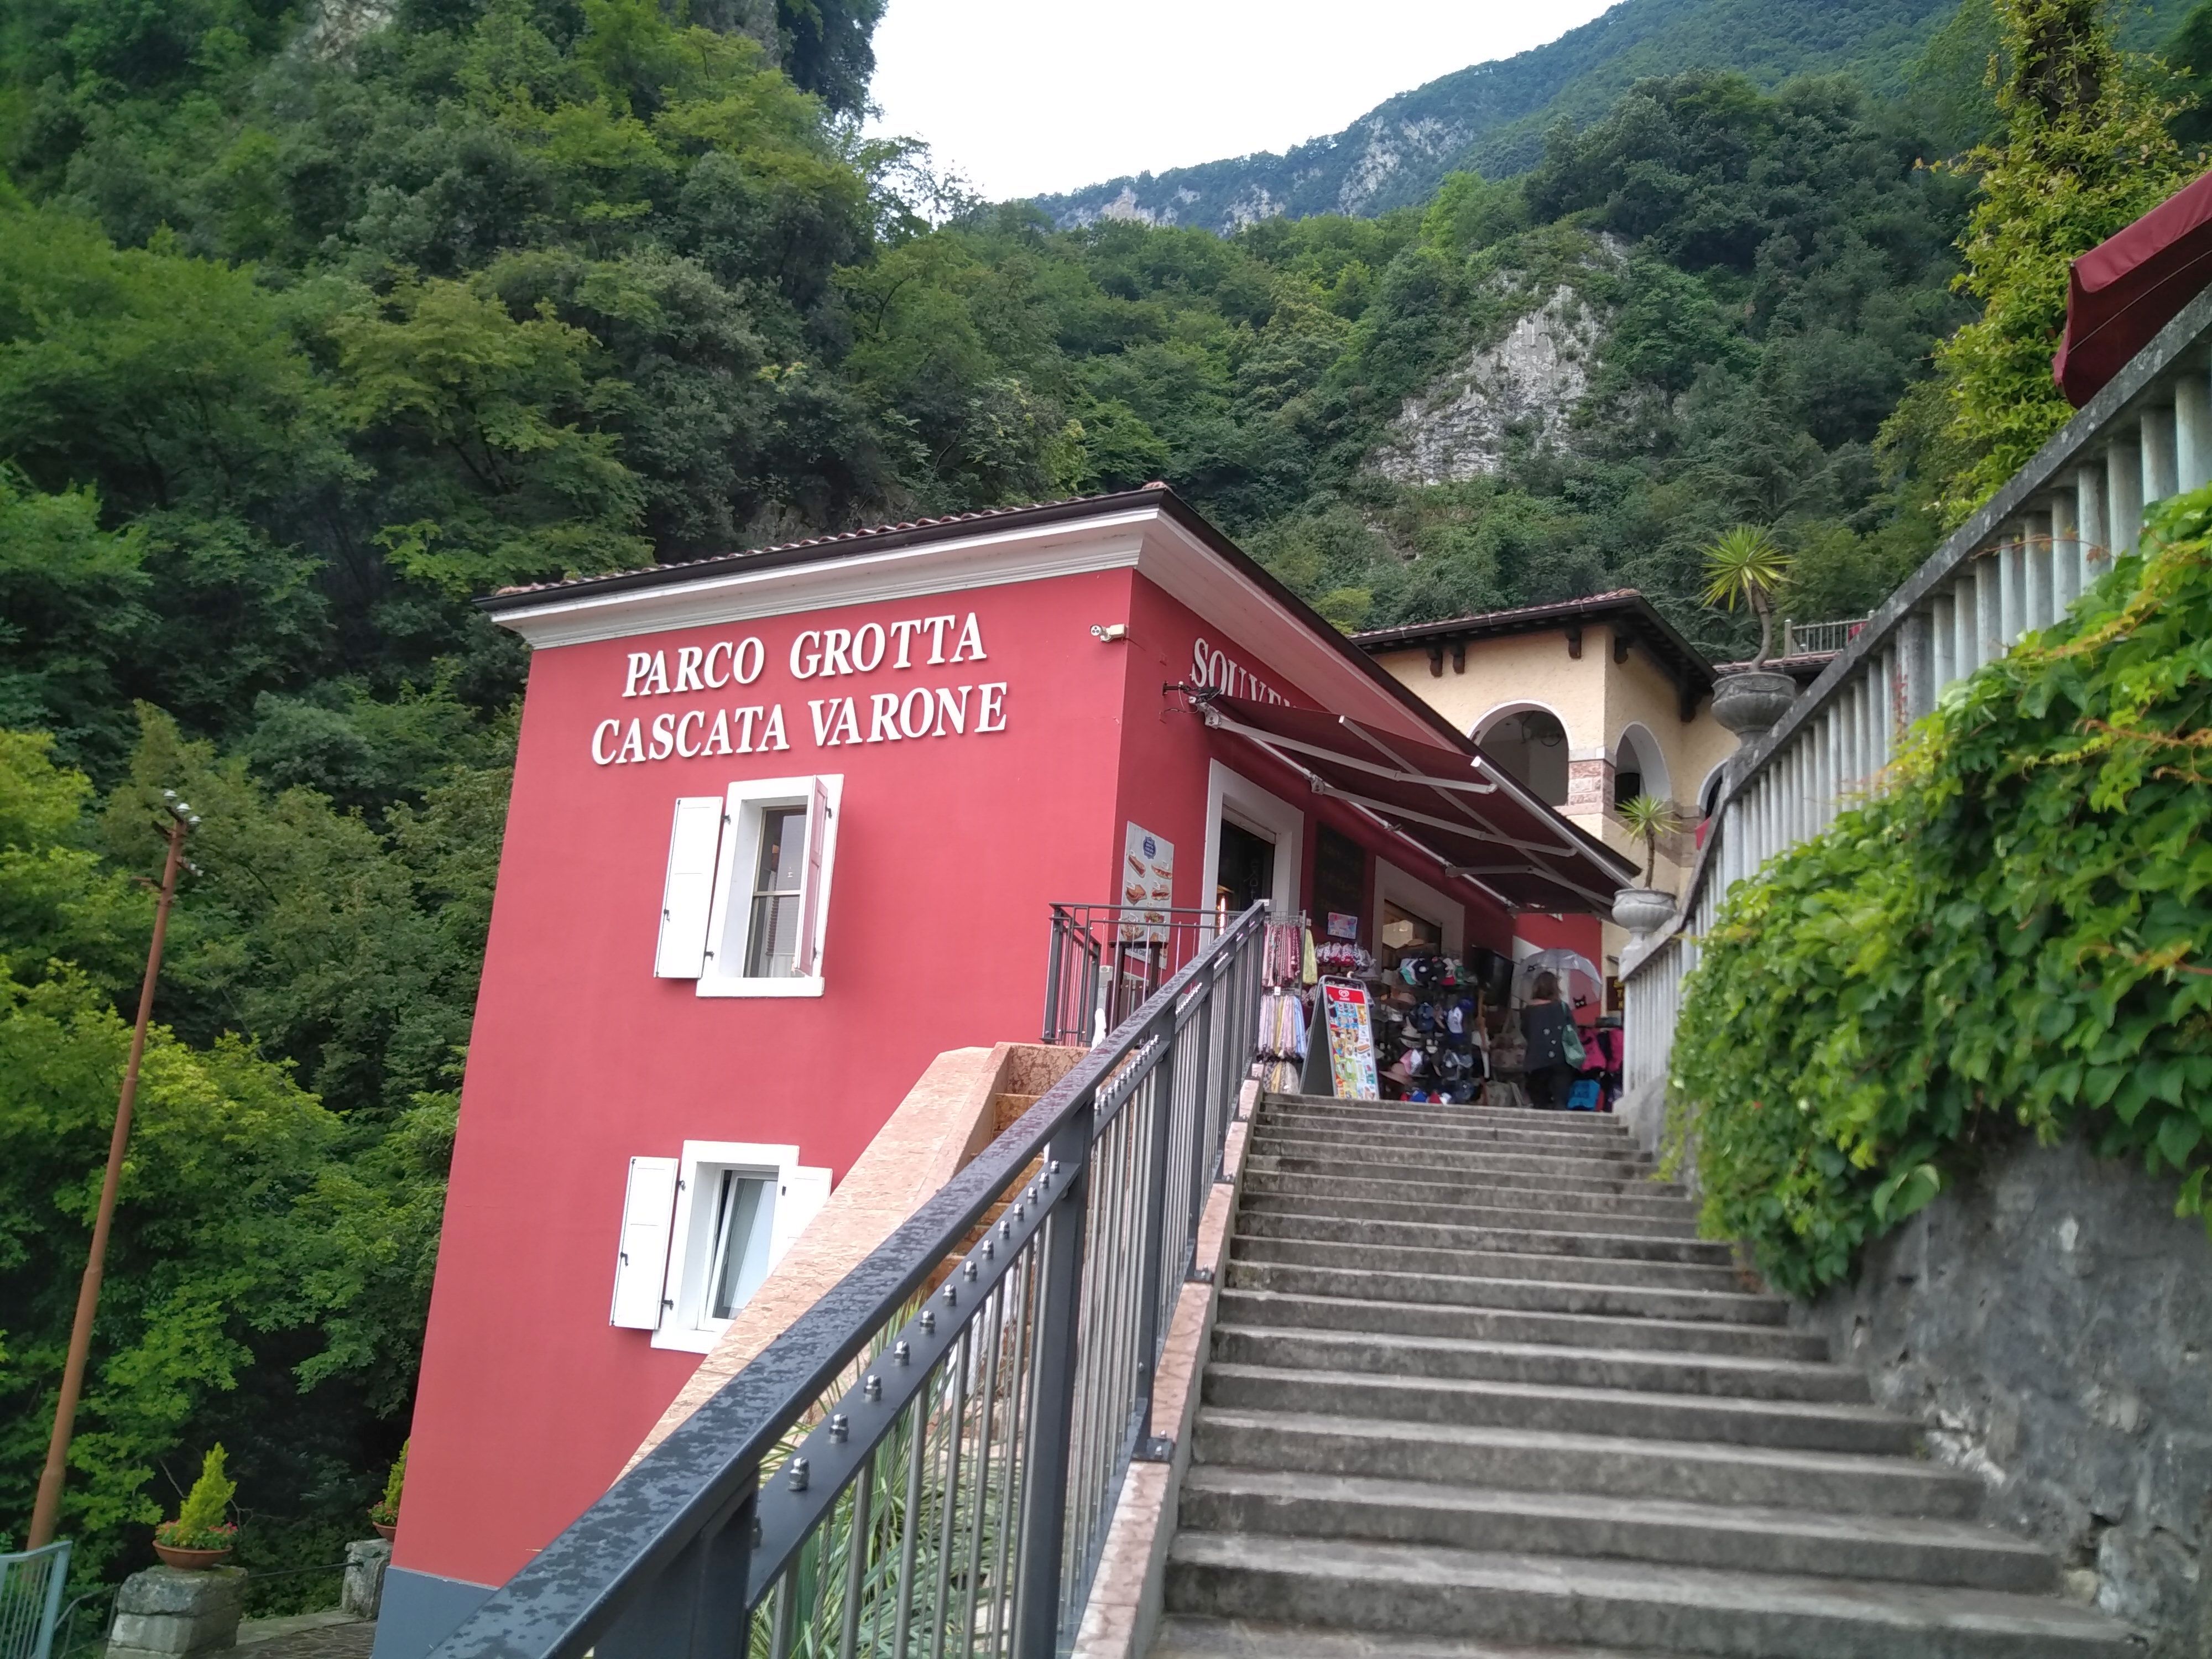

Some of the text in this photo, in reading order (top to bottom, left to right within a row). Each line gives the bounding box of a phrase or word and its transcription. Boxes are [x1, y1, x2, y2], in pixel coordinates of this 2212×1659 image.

[622, 613, 987, 697] PARCO GROTTA
[1191, 638, 1297, 708] SOUV
[592, 682, 1006, 764] CASCATA VARONE
